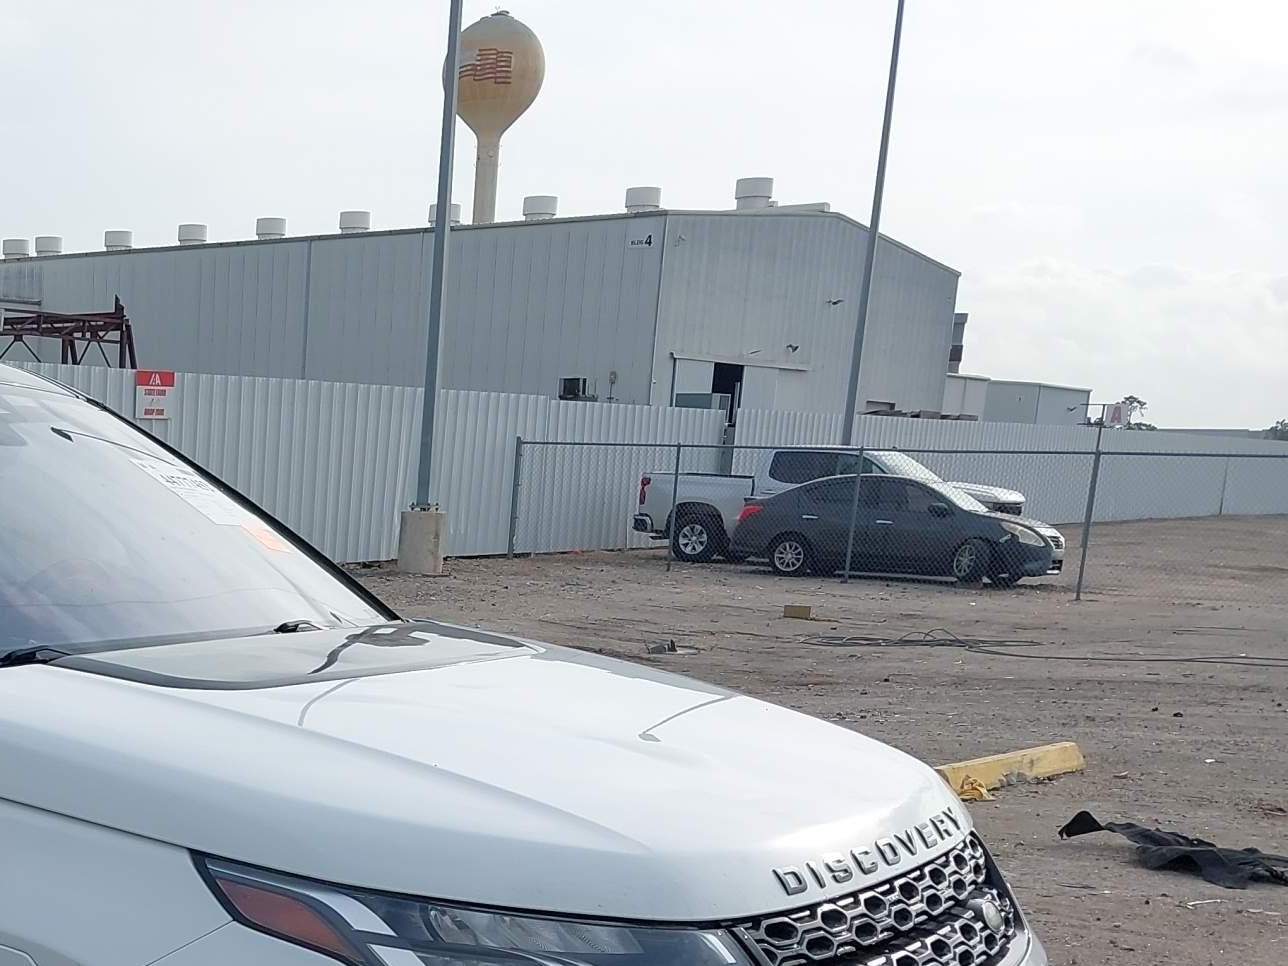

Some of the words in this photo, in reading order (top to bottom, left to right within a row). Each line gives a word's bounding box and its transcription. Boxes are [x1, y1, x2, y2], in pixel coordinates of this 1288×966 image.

[644, 234, 653, 247] 4
[1111, 405, 1122, 423] A
[772, 806, 962, 896] DISCOVERY
